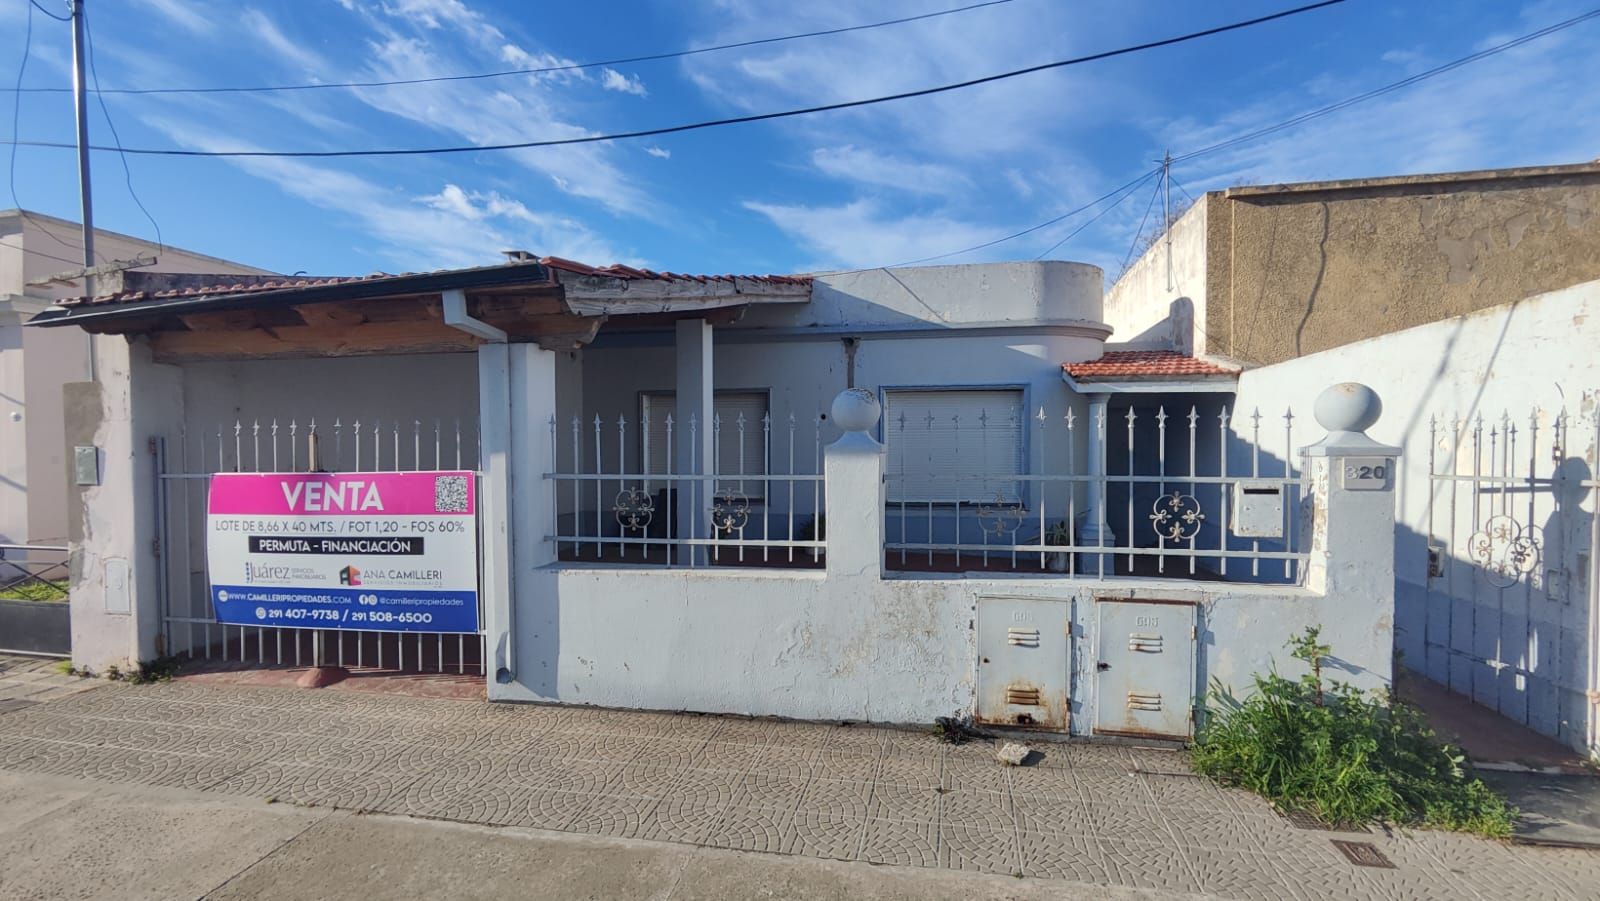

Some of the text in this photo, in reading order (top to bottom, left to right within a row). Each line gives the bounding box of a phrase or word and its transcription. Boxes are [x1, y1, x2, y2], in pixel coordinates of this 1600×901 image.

[281, 481, 384, 511] VENTA
[216, 520, 240, 531] LOTE
[242, 521, 255, 532] DE
[258, 521, 279, 533] 8,66
[282, 521, 289, 532] X
[292, 521, 307, 532] 40
[310, 521, 337, 532] MTS.
[340, 520, 345, 534] /
[349, 521, 371, 532] FOT
[375, 521, 399, 534] 1,20
[411, 521, 435, 532] FOS
[438, 521, 465, 532] 60%
[259, 539, 311, 552] PERMUTA
[321, 537, 411, 553] FINANCIACIÓN
[363, 569, 442, 580] ANA CAMILLERI
[228, 593, 352, 604] WWW.CAMILLERIPROPIEDADES.COM
[380, 597, 464, 607] @camilleripropiedades
[268, 609, 432, 623] 291 407-9738 / 291 508-6500
